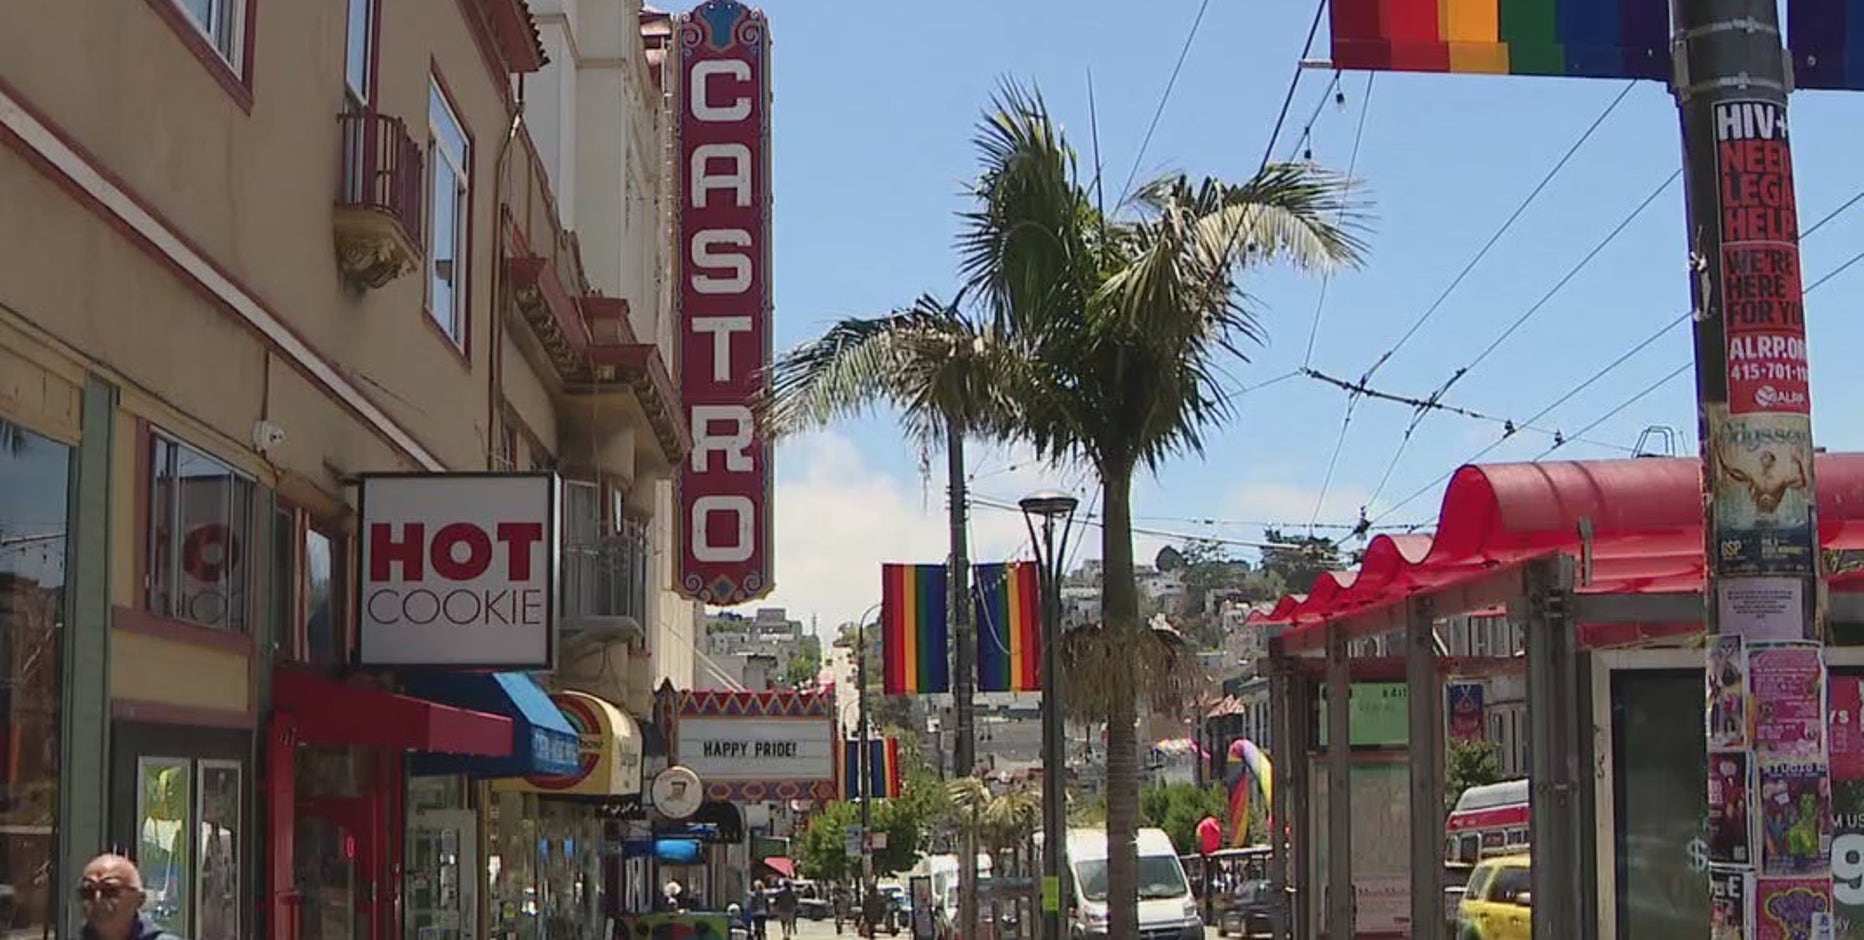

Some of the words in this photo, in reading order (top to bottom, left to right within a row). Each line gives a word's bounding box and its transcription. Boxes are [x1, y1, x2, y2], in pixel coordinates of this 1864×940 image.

[1726, 249, 1794, 276] WE'RE
[1727, 274, 1787, 300] HERE
[690, 60, 754, 563] CASTRO
[1728, 300, 1774, 325] FOR
[370, 522, 543, 582] HOT
[368, 588, 541, 625] COOKIE
[703, 741, 748, 757] HAPPY
[755, 741, 797, 757] PRIDE!
